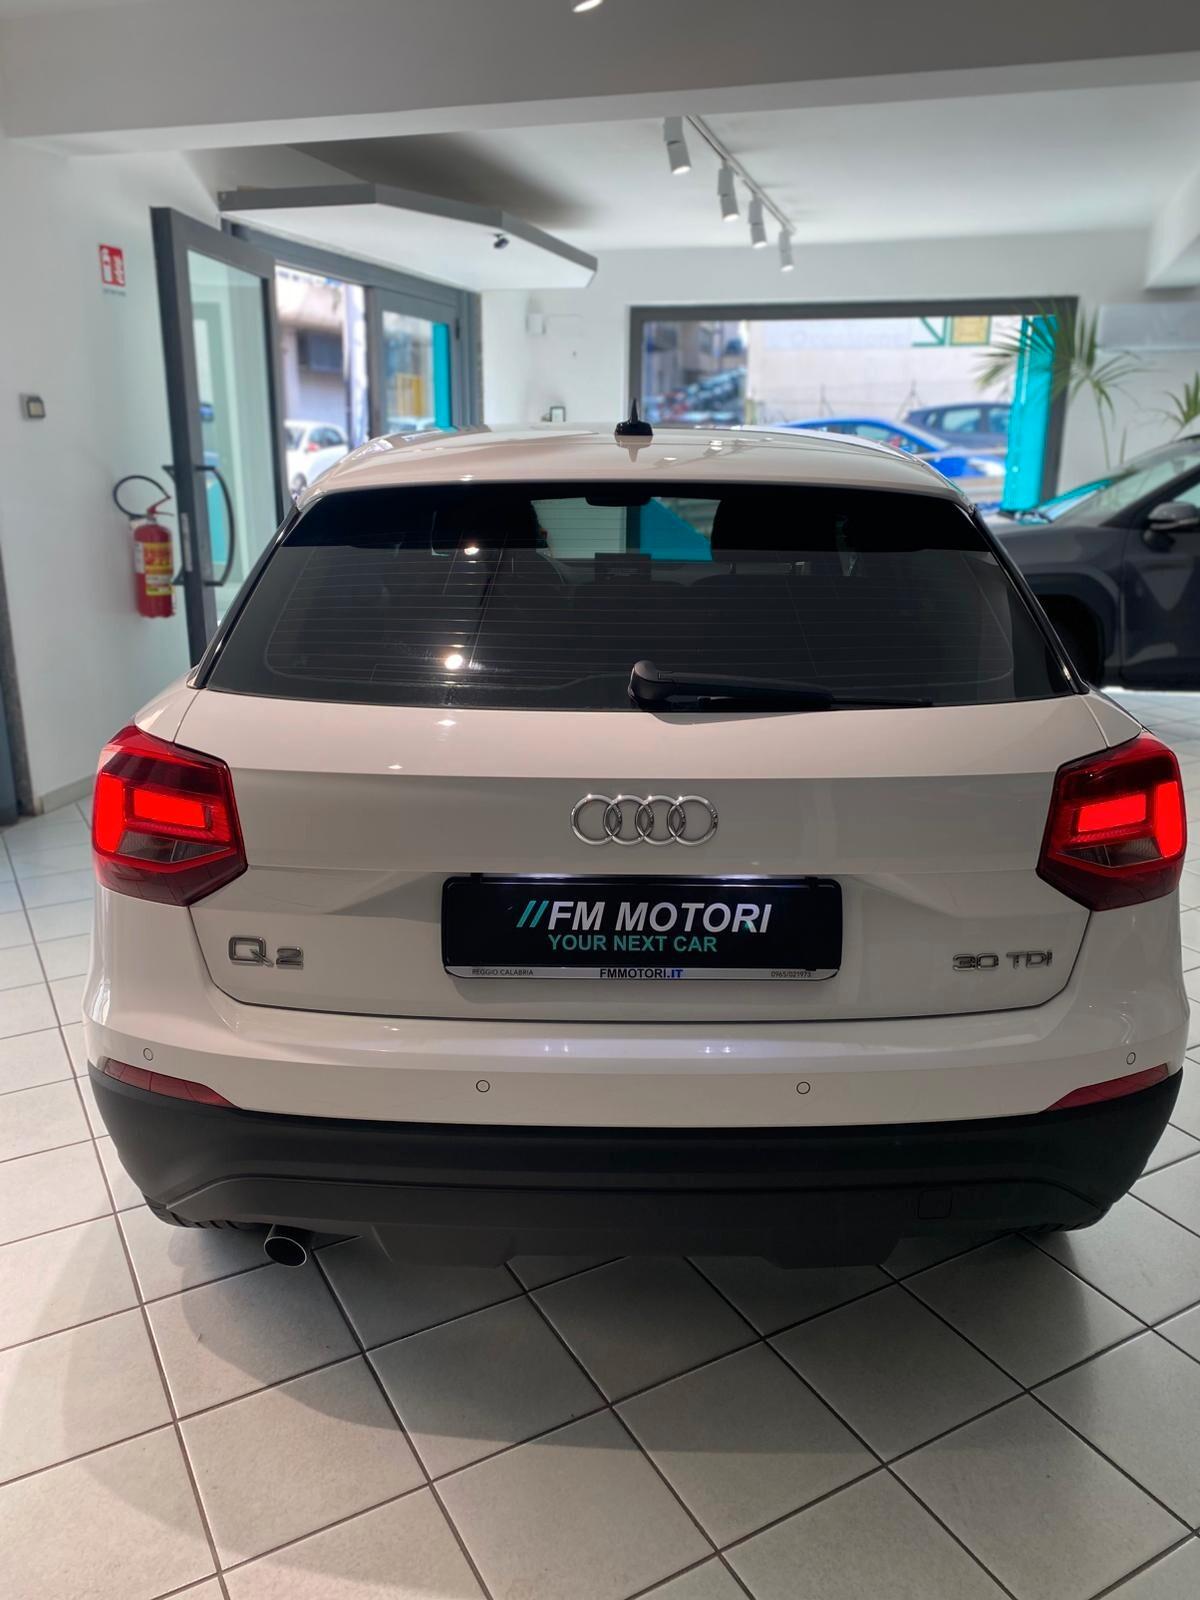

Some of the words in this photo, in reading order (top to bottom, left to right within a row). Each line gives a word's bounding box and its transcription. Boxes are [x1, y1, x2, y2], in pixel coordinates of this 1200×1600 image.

[615, 902, 773, 933] MOTORI
[228, 935, 304, 969] Q2
[548, 934, 607, 950] YOUR
[613, 935, 668, 951] NEXT
[673, 936, 718, 952] CAR
[952, 953, 1000, 971] 30
[1006, 950, 1053, 969] TDI
[500, 968, 534, 977] CALABRIA
[600, 968, 684, 978] FMMOTORI.IT
